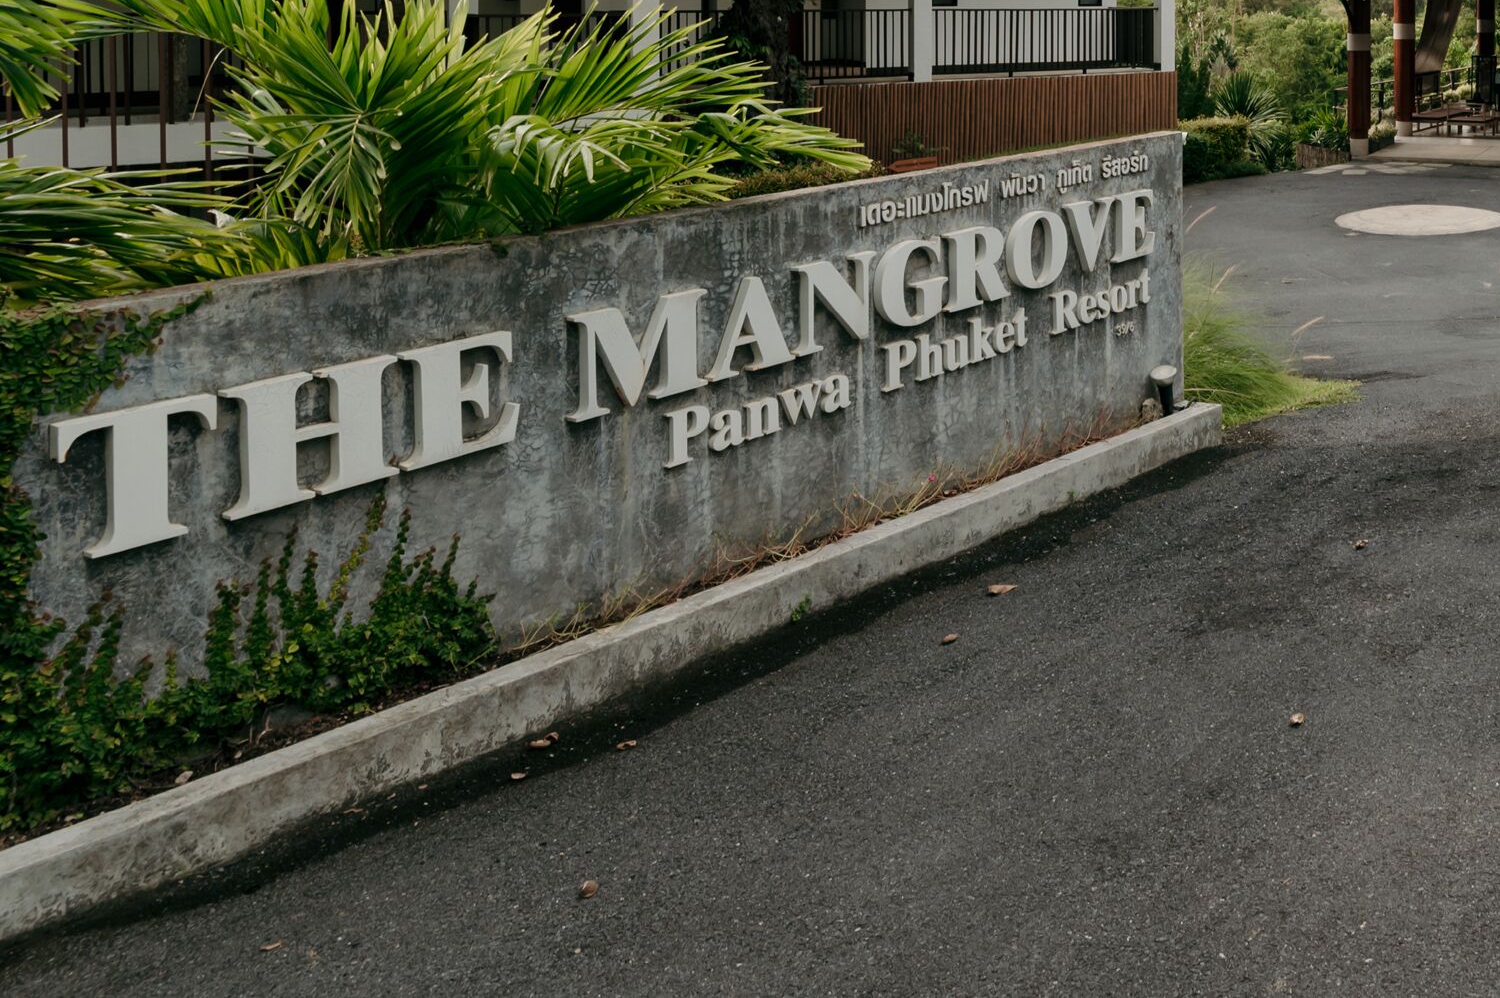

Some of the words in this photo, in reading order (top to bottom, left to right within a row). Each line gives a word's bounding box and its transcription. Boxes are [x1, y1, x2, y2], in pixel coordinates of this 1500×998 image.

[860, 179, 989, 227] เดอะแมงโกรฟ
[1001, 173, 1046, 199] พันวา
[1056, 158, 1093, 195] ภูเก็ต
[49, 330, 520, 560] THE
[565, 188, 1156, 423] MANGROVE
[663, 373, 852, 469] Panwa
[880, 306, 1029, 394] Phuket
[1050, 267, 1151, 336] Resort
